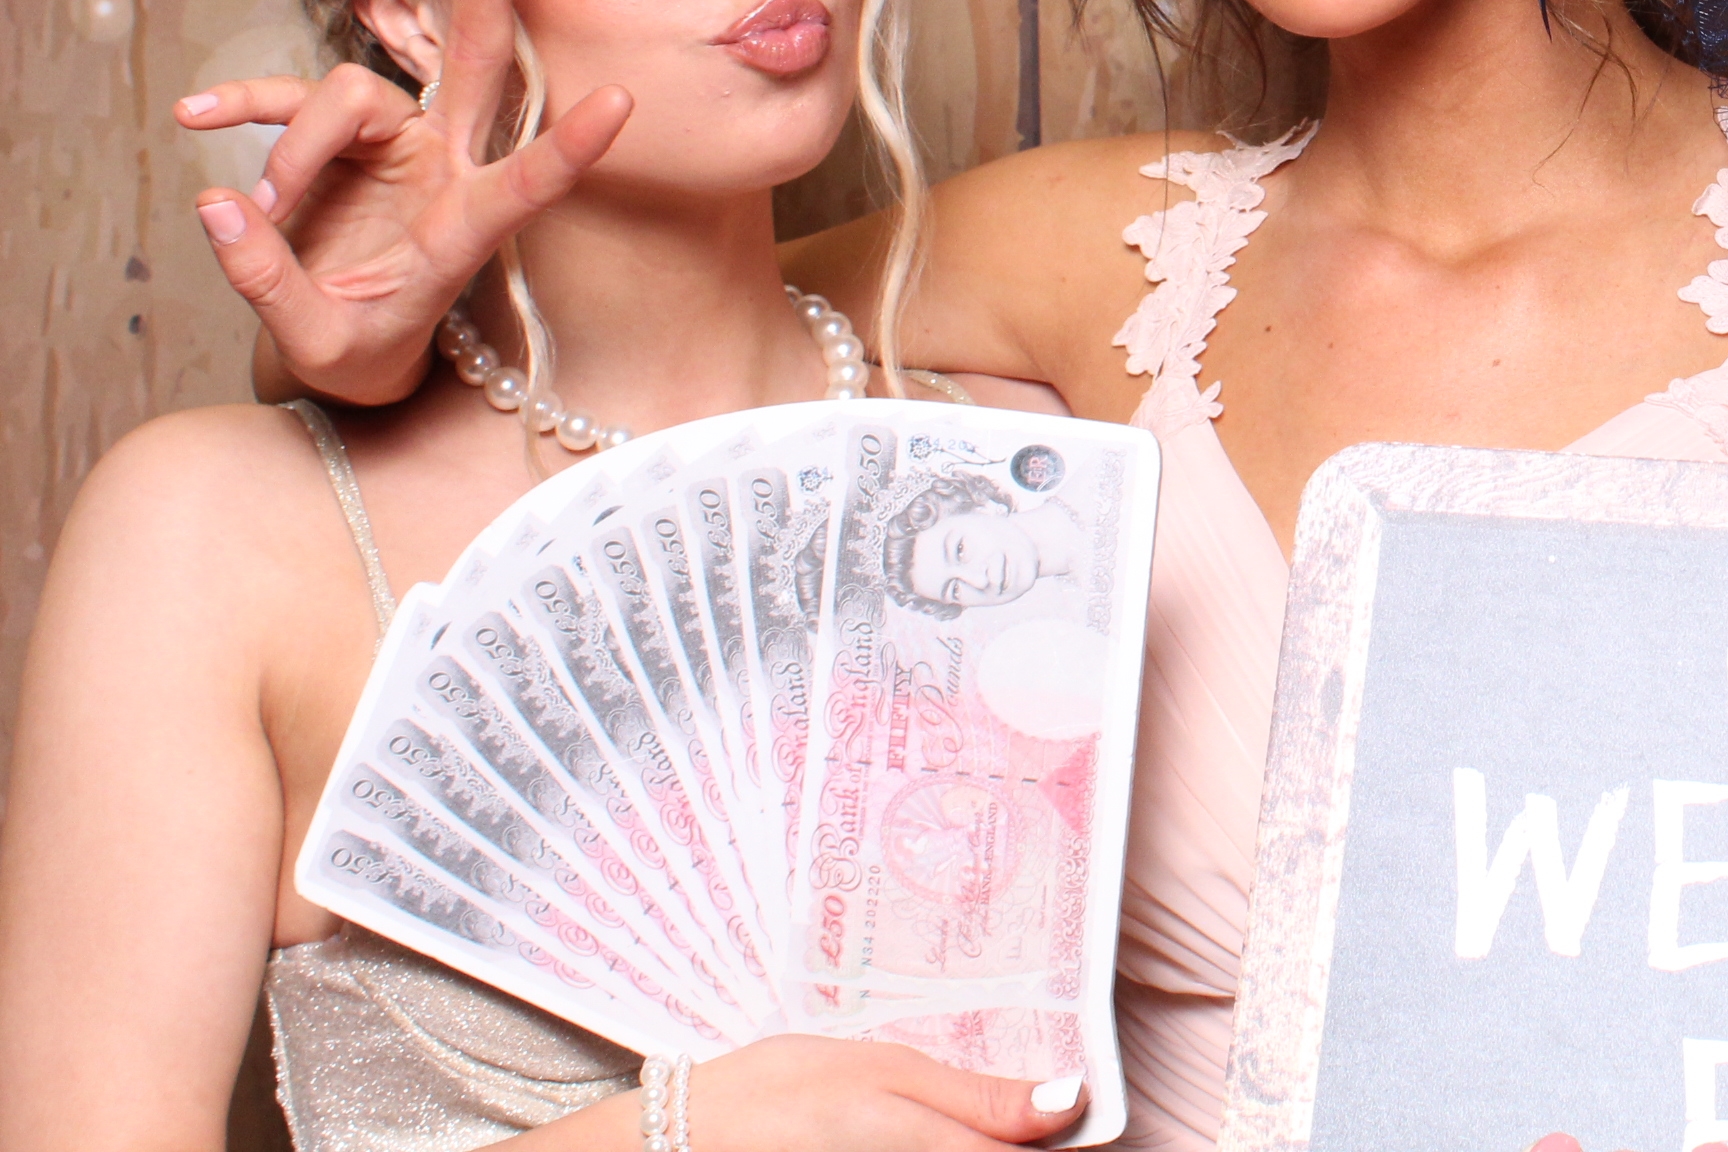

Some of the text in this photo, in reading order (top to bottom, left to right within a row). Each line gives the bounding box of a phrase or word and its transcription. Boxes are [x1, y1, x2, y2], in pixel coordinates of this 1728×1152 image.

[857, 433, 882, 505] £50
[699, 489, 732, 555] £50
[751, 478, 779, 551] £50
[603, 540, 646, 597] £50
[654, 519, 690, 580] £50
[534, 580, 581, 635] £50
[475, 628, 525, 679] £50
[429, 671, 480, 719] £50
[887, 661, 913, 773] FIFTY
[914, 636, 964, 767] Pounds
[388, 735, 447, 779] £50
[808, 618, 883, 892] Bank of England
[351, 779, 410, 820] £50
[330, 848, 395, 884] £50
[820, 894, 846, 968] £50
[861, 864, 881, 967] N34 202220
